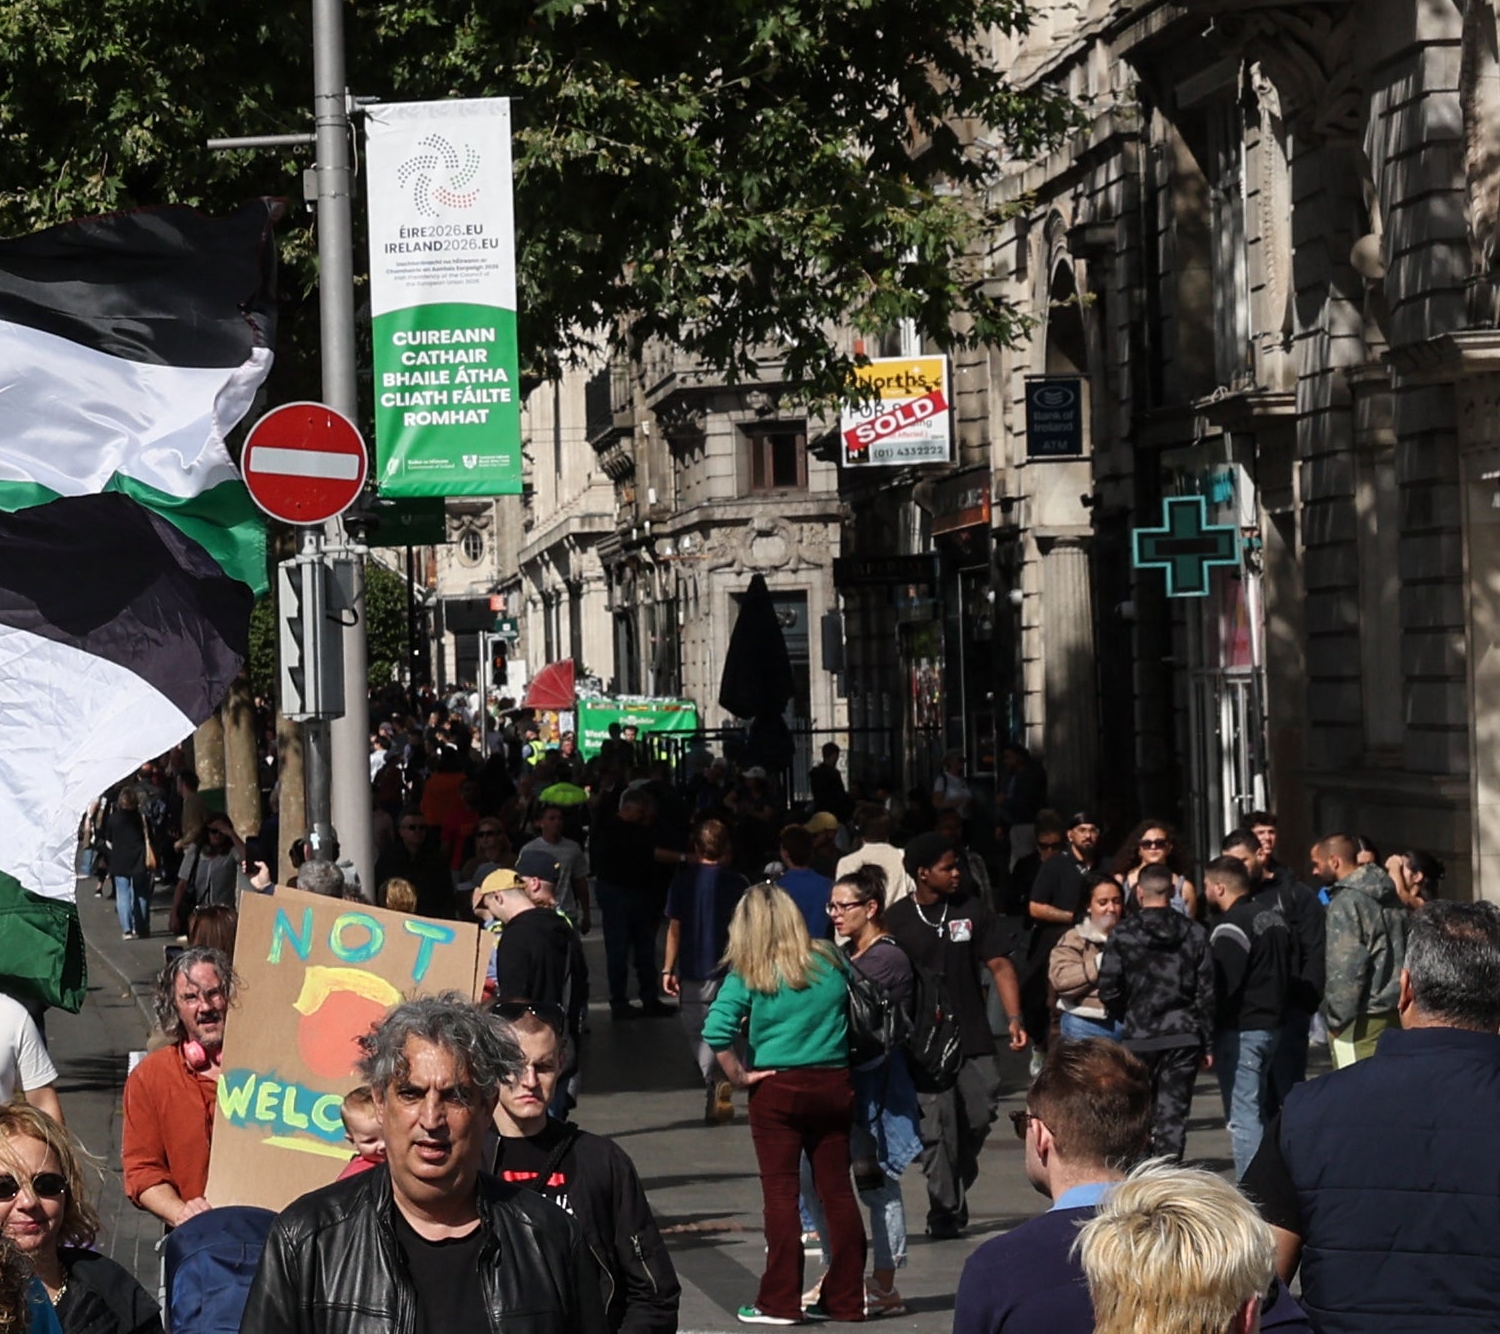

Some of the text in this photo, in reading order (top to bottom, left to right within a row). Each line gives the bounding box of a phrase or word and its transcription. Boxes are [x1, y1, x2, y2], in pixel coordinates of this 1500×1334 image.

[399, 224, 483, 238] ÉIRE2026.EU
[384, 238, 499, 254] IRELAND2026.EU
[392, 328, 495, 346] CUIREANN
[401, 348, 487, 366] CATHAIR
[383, 365, 508, 387] BHAILE ÁTHA
[380, 385, 511, 407] CLIATH FÁILTE
[403, 409, 489, 427] ROMHAT
[854, 398, 934, 443] SOLD
[266, 907, 456, 984] NOT
[216, 1073, 345, 1133] WELC
